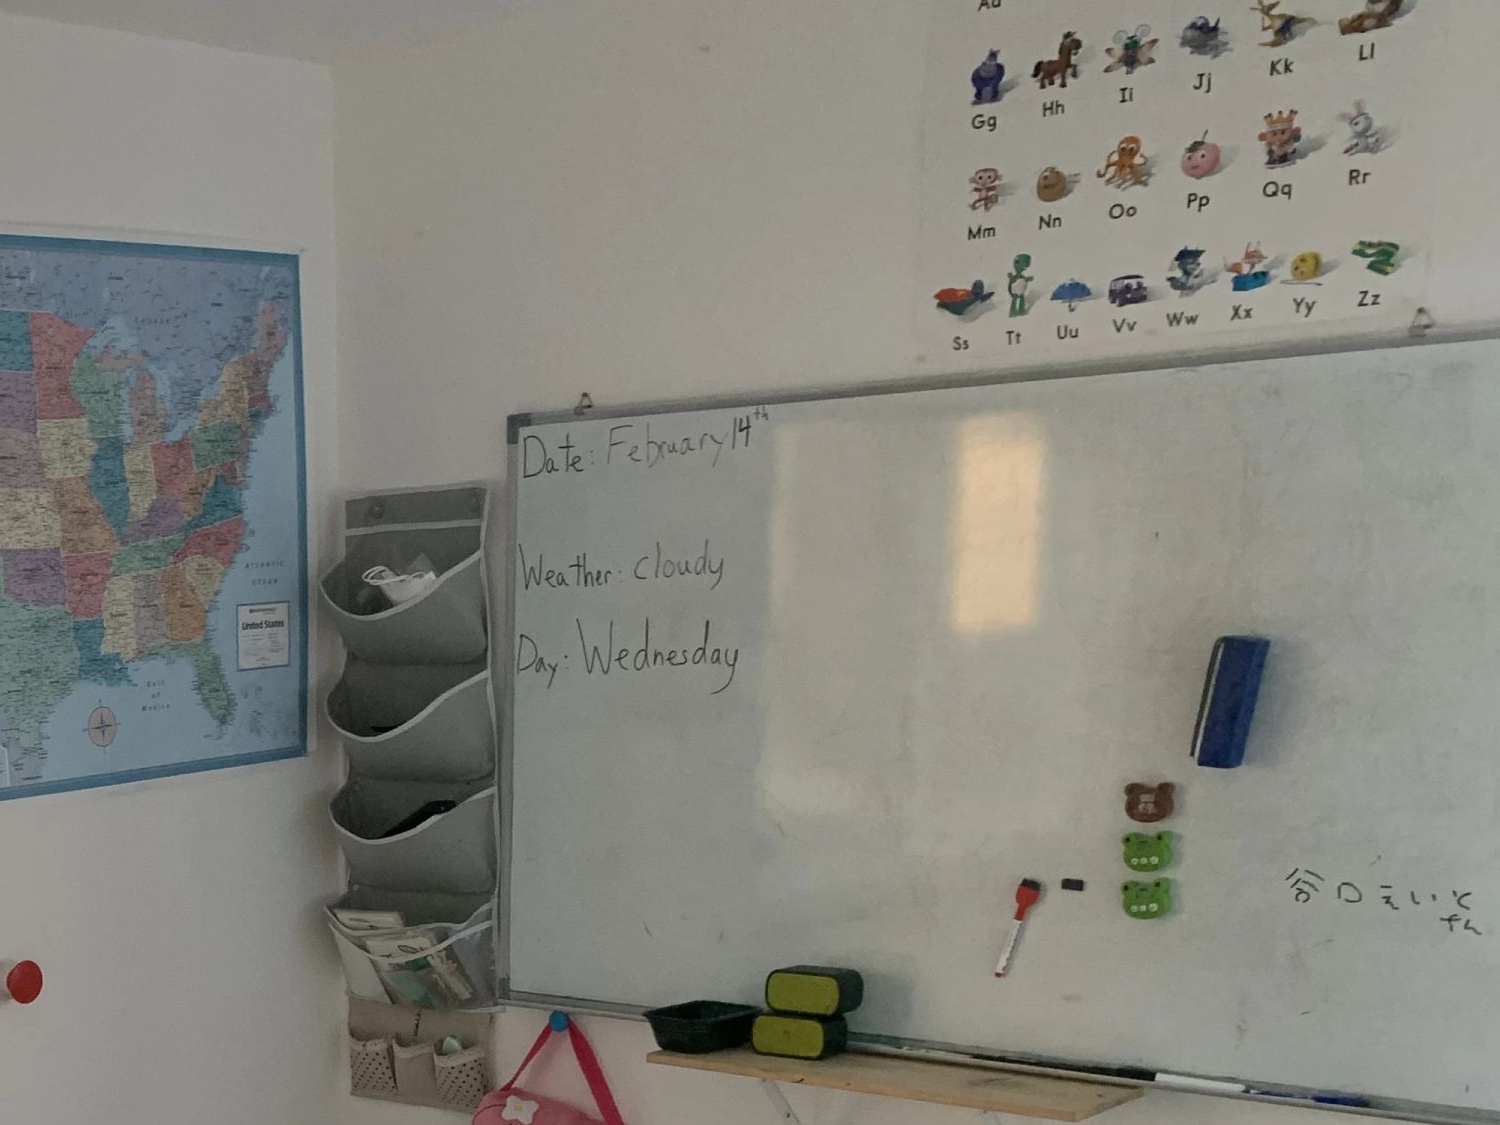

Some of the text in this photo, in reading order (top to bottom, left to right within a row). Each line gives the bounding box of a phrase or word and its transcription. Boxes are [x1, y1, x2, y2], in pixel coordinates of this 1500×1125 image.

[972, 42, 1375, 132] Gg Hh Ii Jj Kk Ll
[968, 169, 1371, 240] Mm Nn Oo Pp Qq Rr
[953, 290, 1380, 351] Ss Tt Uu Vv Ww Xx Yy Zz
[523, 432, 594, 478] Date:
[519, 544, 622, 590] Weather:
[241, 618, 285, 631] United States
[517, 617, 738, 695] Day: Wednesday
